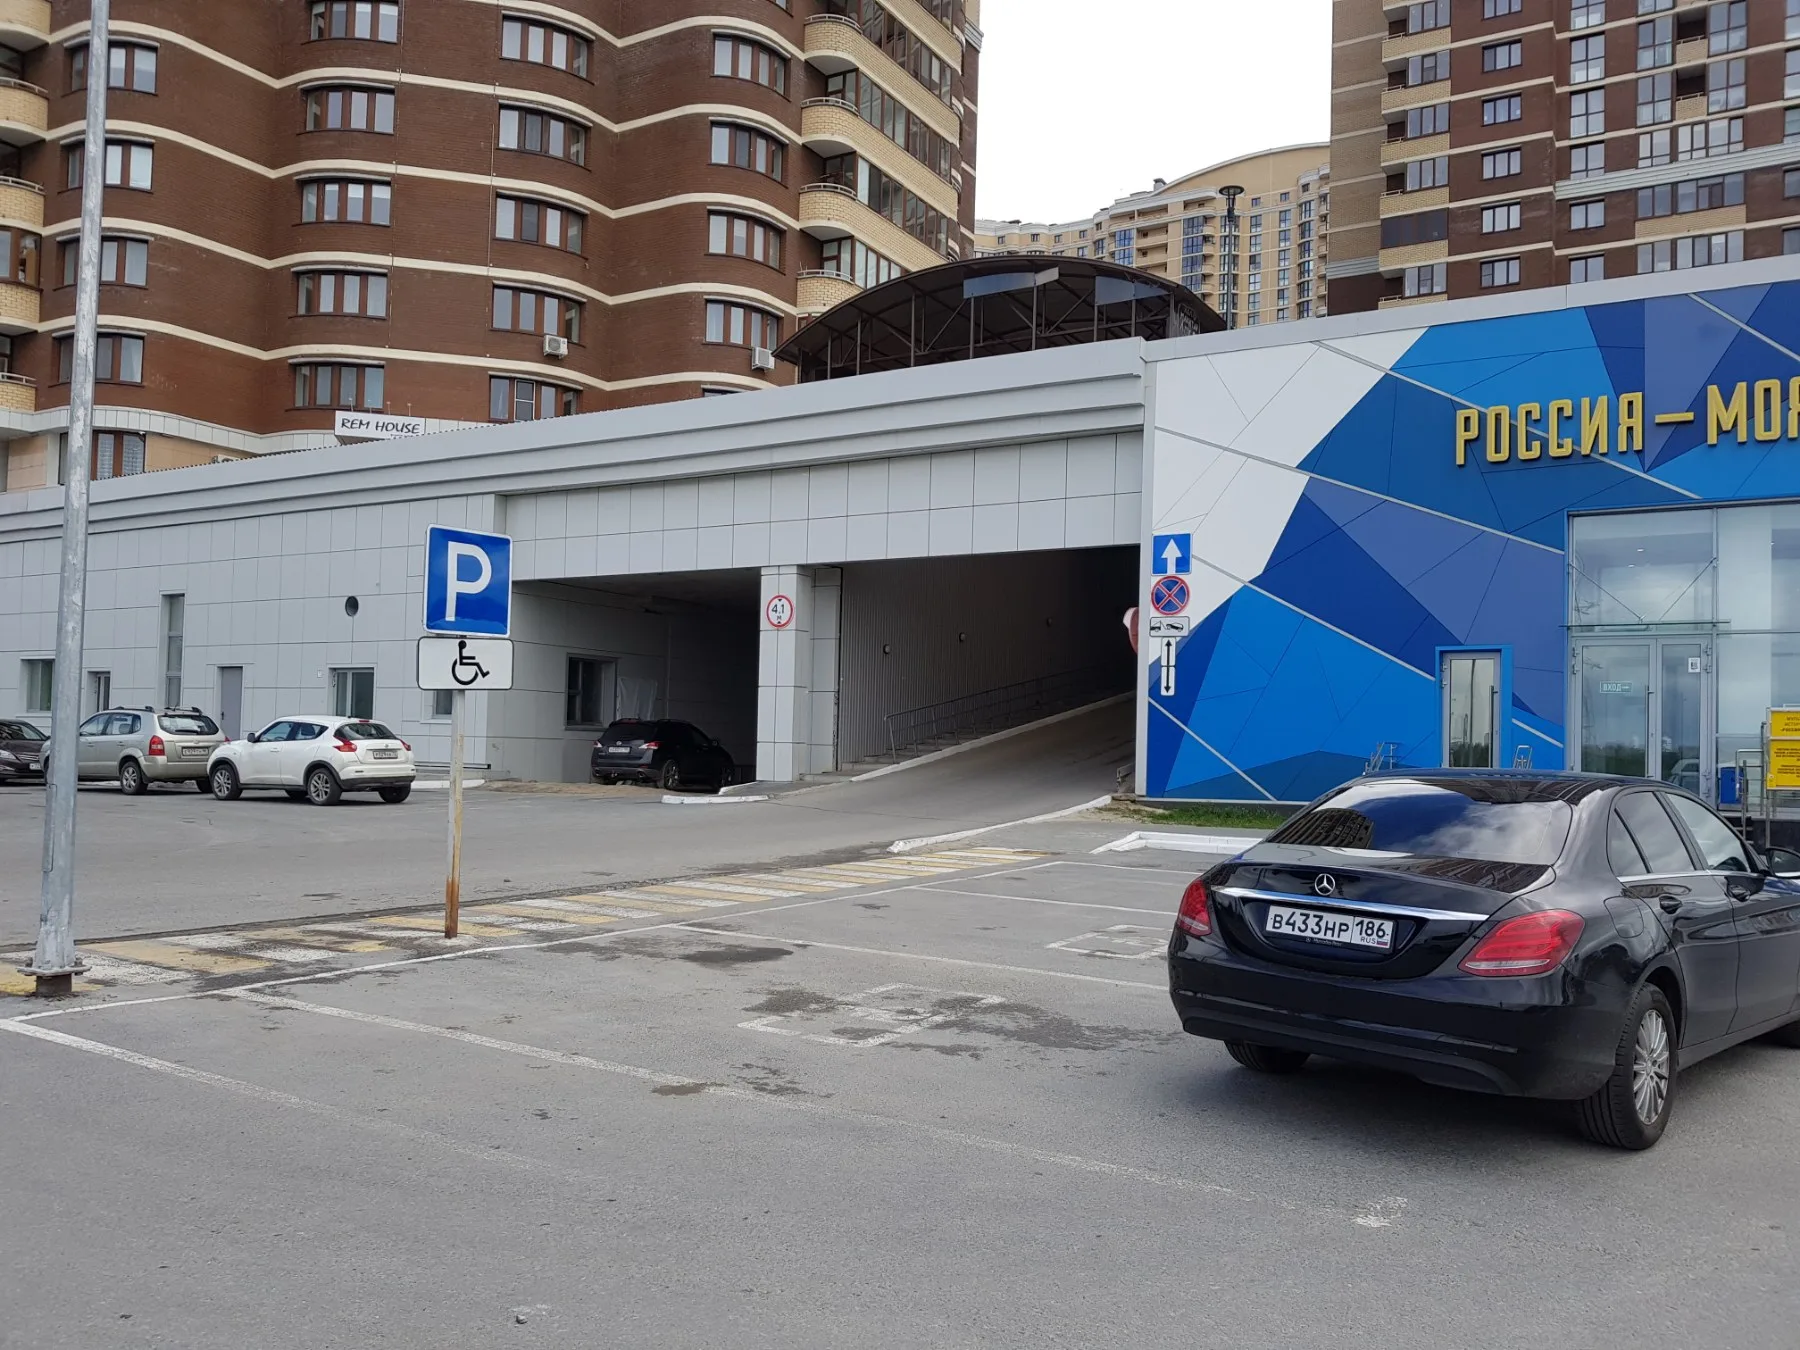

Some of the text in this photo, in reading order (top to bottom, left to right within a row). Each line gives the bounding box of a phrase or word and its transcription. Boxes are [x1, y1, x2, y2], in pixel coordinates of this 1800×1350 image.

[341, 417, 420, 434] REM HOUSE
[1456, 391, 1643, 466] РОССИЯ
[445, 540, 492, 622] P
[1602, 683, 1622, 692] ВХОД
[1271, 911, 1386, 939] В433НР 186
[1360, 936, 1377, 945] RUS
